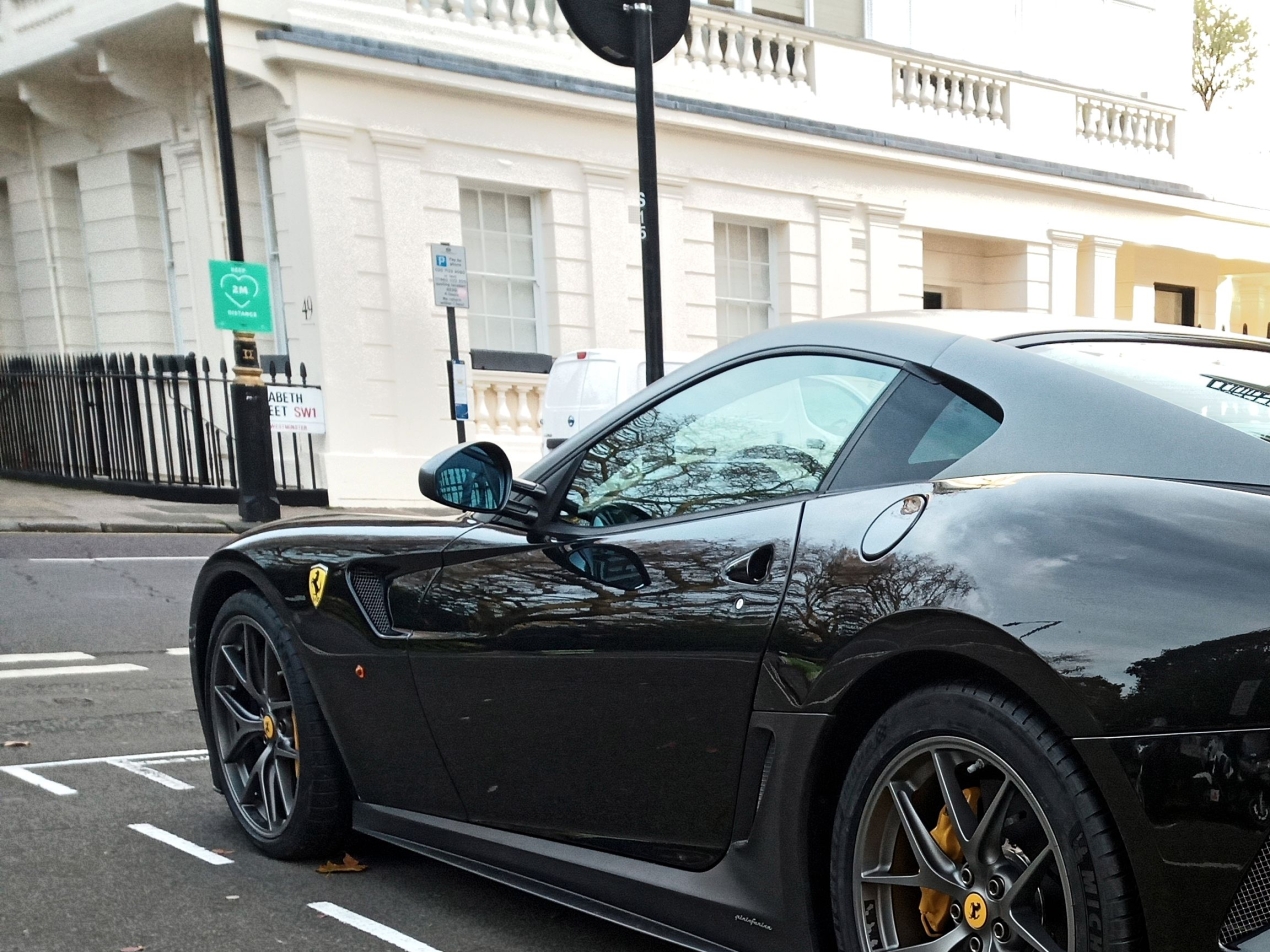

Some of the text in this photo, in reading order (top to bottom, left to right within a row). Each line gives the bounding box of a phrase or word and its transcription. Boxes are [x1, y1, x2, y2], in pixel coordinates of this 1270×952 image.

[232, 285, 249, 295] 2M
[227, 309, 258, 318] DISTANCE
[302, 295, 313, 320] 49
[268, 391, 303, 404] ABETH
[269, 405, 317, 418] EET SW1
